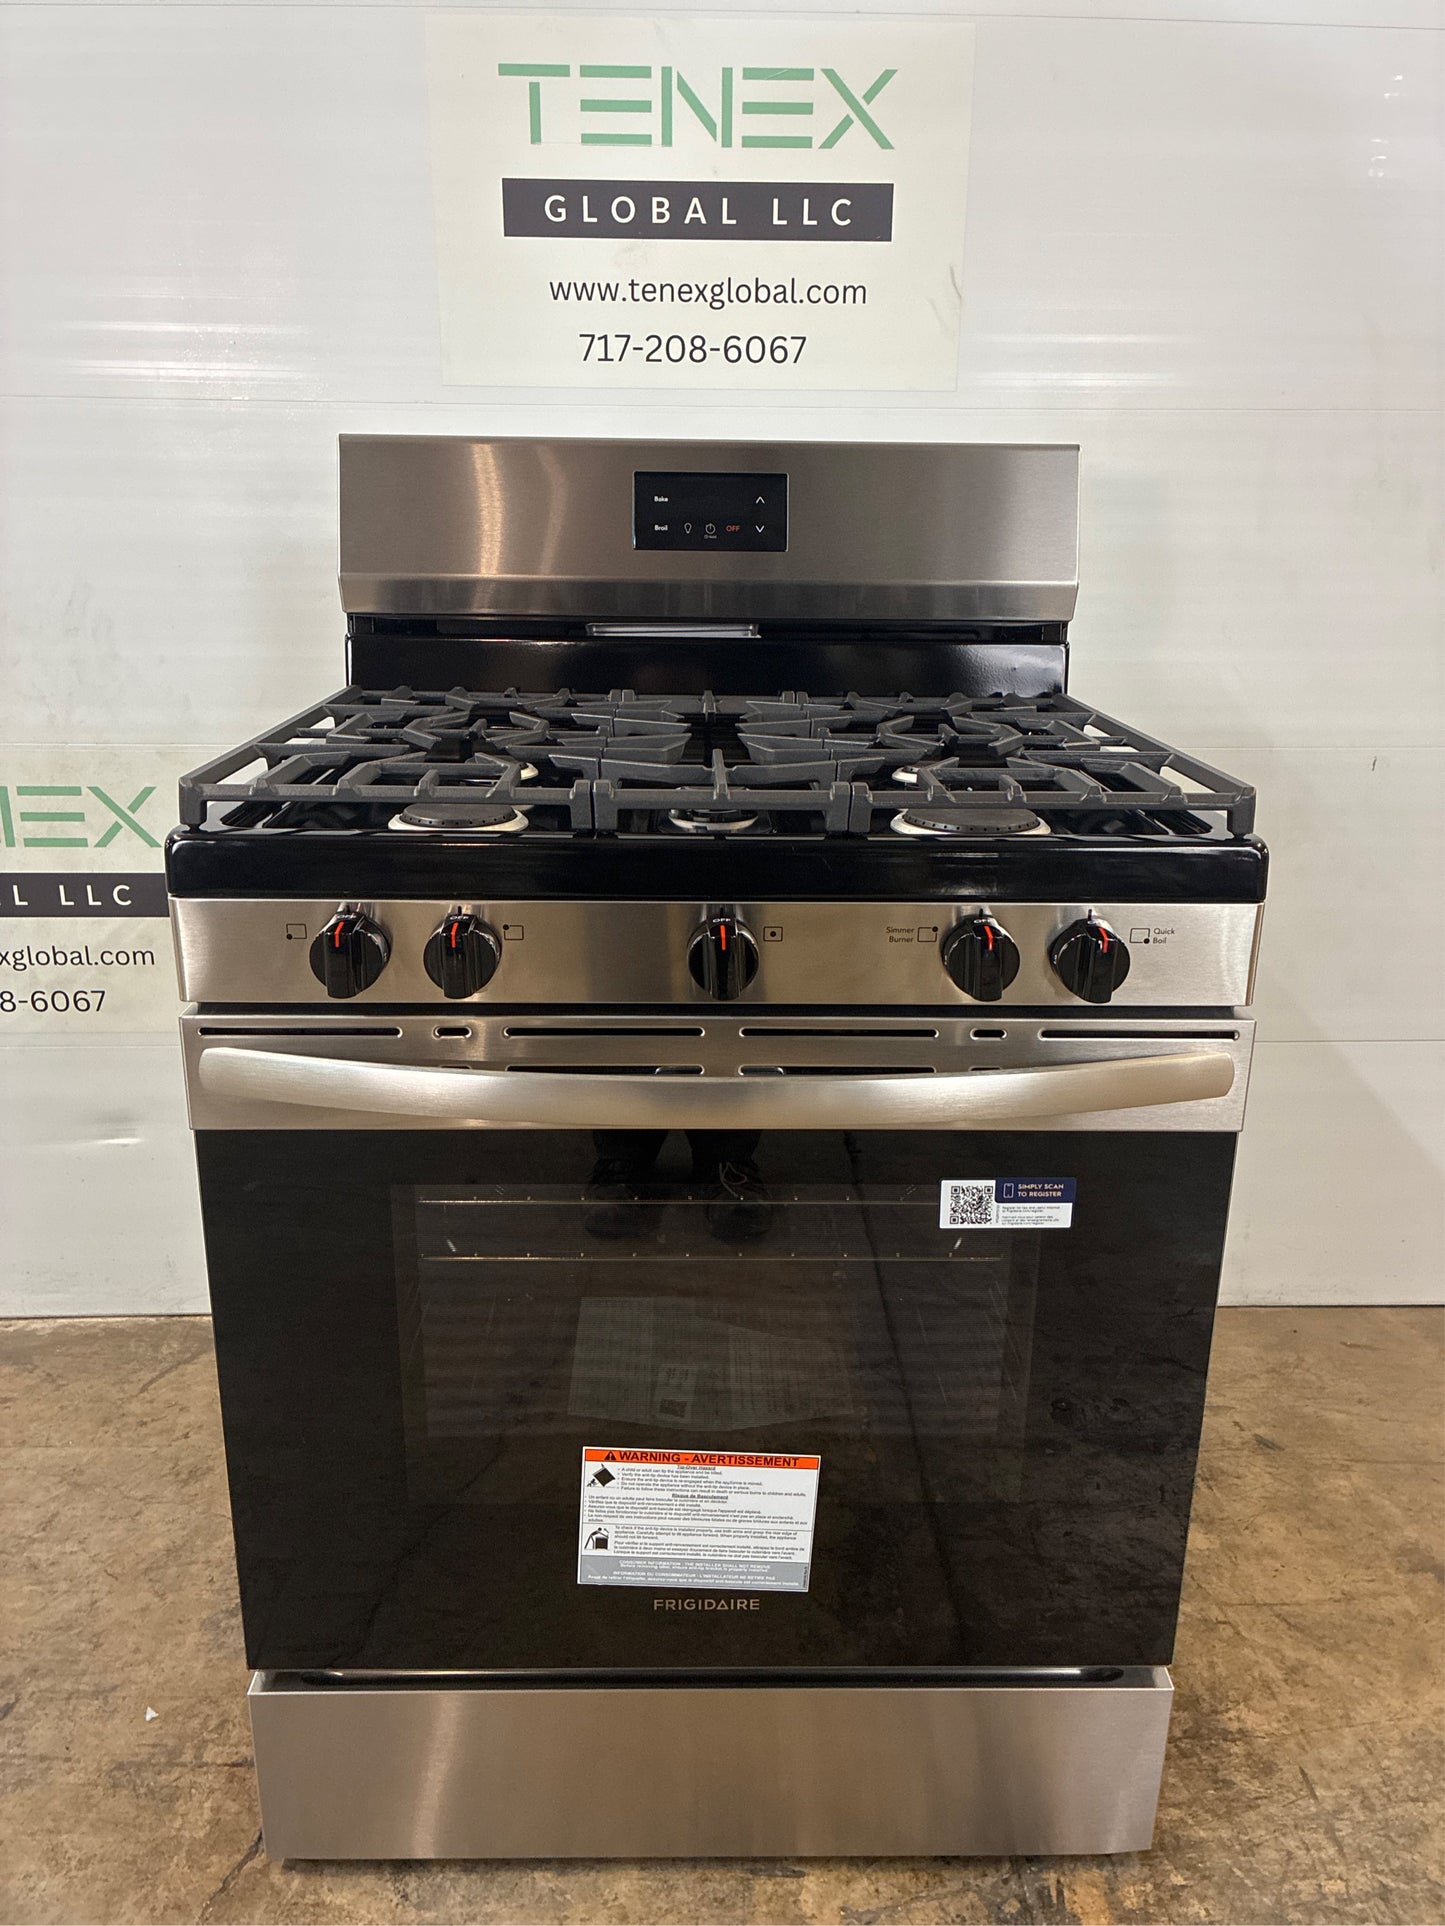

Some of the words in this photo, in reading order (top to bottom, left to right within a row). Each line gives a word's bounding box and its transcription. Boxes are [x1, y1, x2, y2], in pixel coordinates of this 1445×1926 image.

[498, 63, 898, 149] TENEX
[543, 194, 737, 226] GLOBAL
[771, 197, 853, 226] LLC
[549, 277, 868, 311] www.tenexglobal.com
[578, 333, 807, 364] 717-208-6067
[58, 884, 132, 906] LLC
[886, 926, 914, 934] Simmer
[1152, 937, 1168, 945] Boil
[1153, 928, 1176, 936] Quick
[0, 990, 106, 1012] 8-6067
[619, 1450, 681, 1463] WARNING
[692, 1454, 800, 1468] AVERTISSEMENT
[653, 1599, 760, 1610] FRIGIDAIRE
